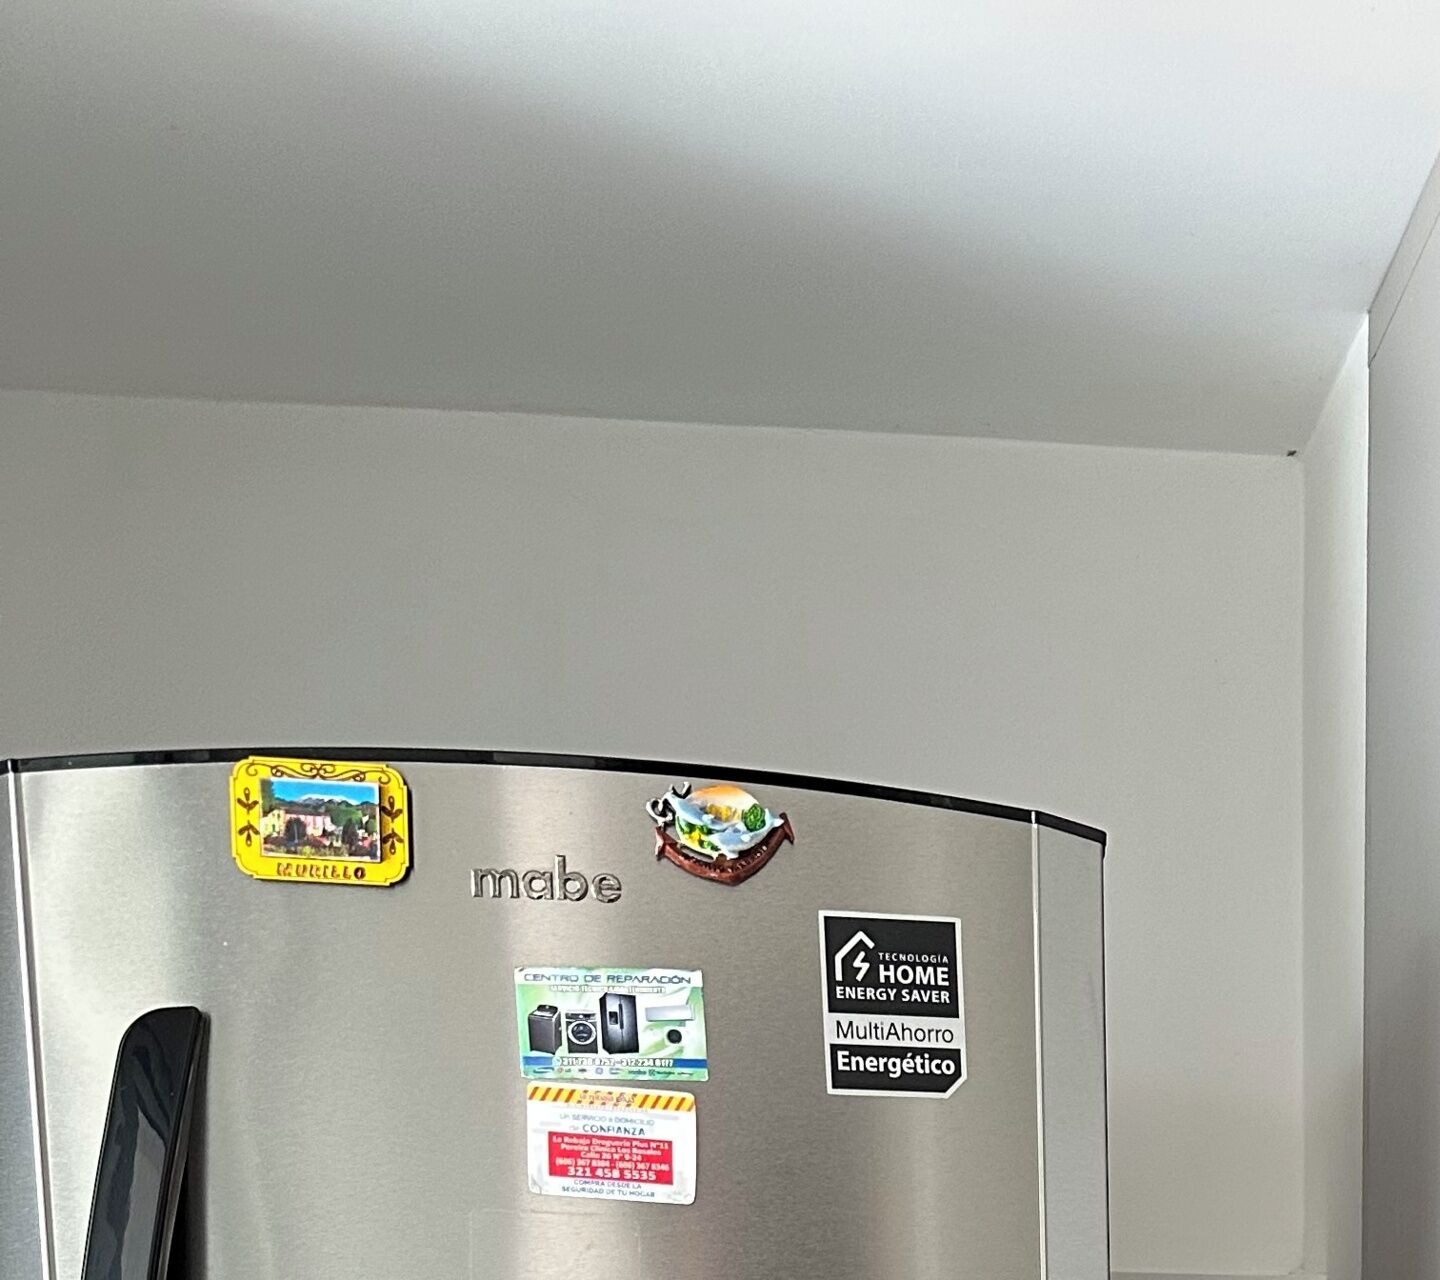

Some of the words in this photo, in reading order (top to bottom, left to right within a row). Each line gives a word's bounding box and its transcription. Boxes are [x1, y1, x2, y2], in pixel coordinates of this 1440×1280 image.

[470, 854, 622, 904] mabe
[878, 951, 949, 963] TECNOLOGÍA
[524, 973, 579, 982] CENTRO
[607, 975, 692, 984] REPARACIÓN
[879, 964, 950, 986] HOME
[836, 985, 898, 1001] ENERGY
[901, 989, 950, 1004] SAVER
[836, 1020, 954, 1043] MultiAhorro
[837, 1050, 955, 1078] Energético
[582, 1124, 646, 1136] CONFIANZA
[567, 1167, 592, 1177] 321
[595, 1168, 621, 1178] 458
[623, 1170, 656, 1181] 5535
